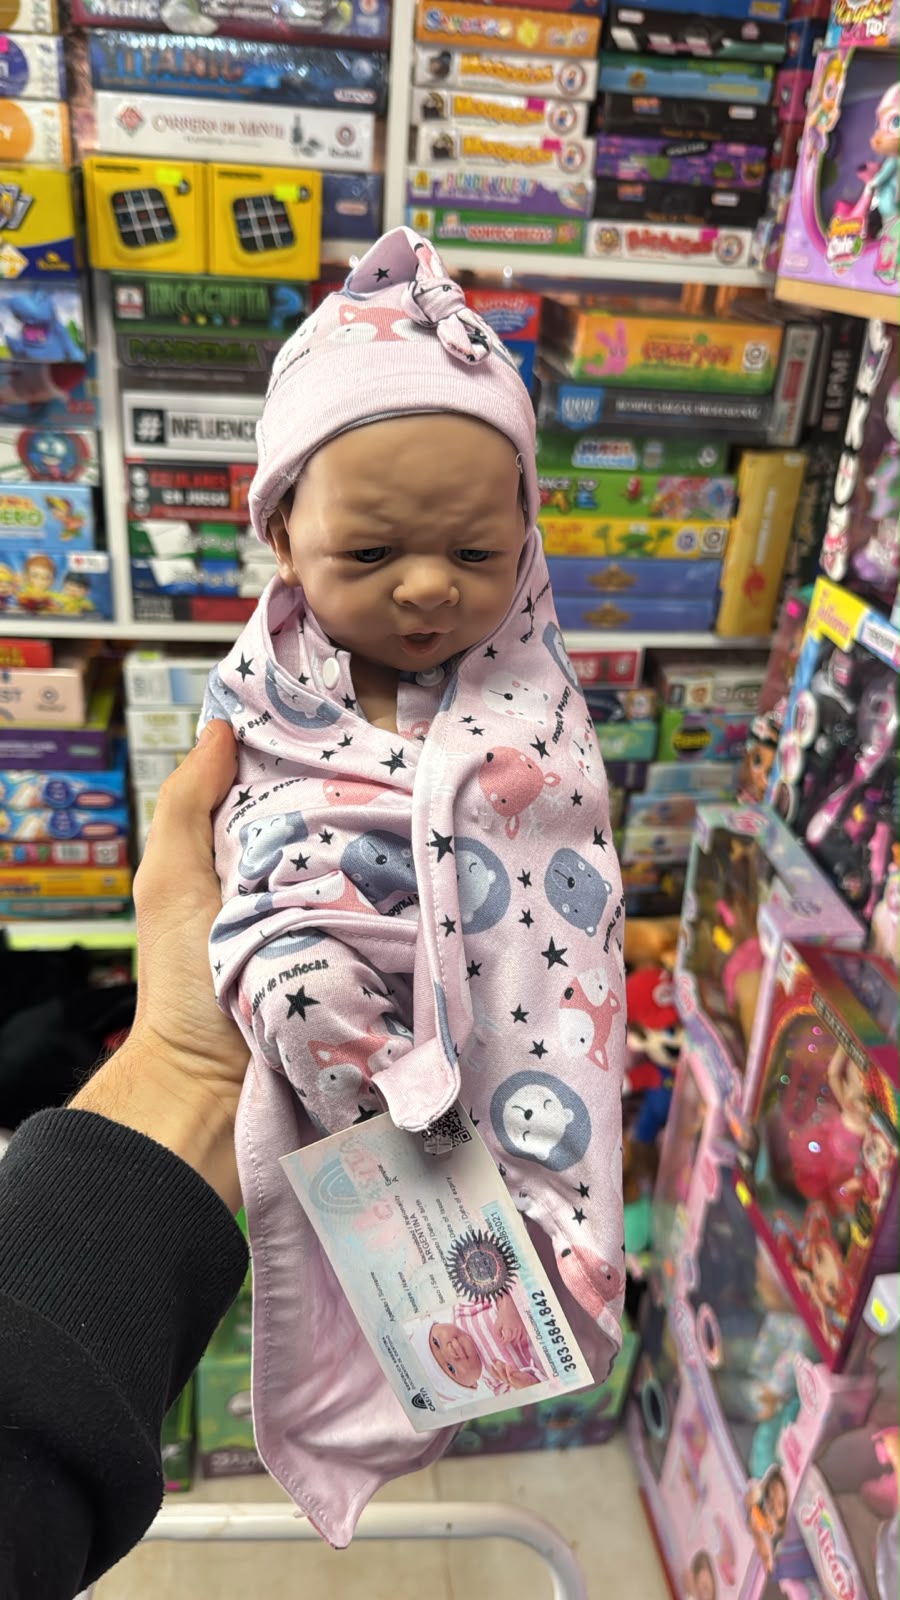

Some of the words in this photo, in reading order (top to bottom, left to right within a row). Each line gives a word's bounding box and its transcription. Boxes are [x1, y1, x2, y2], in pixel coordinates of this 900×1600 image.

[458, 1205, 467, 1219] Date
[409, 1213, 434, 1260] ARGENTINA
[446, 1224, 455, 1238] Date
[382, 1301, 395, 1322] Apellido
[406, 1292, 419, 1313] Nombre
[531, 1289, 576, 1372] 383.584.842
[541, 1346, 558, 1376] Documento
